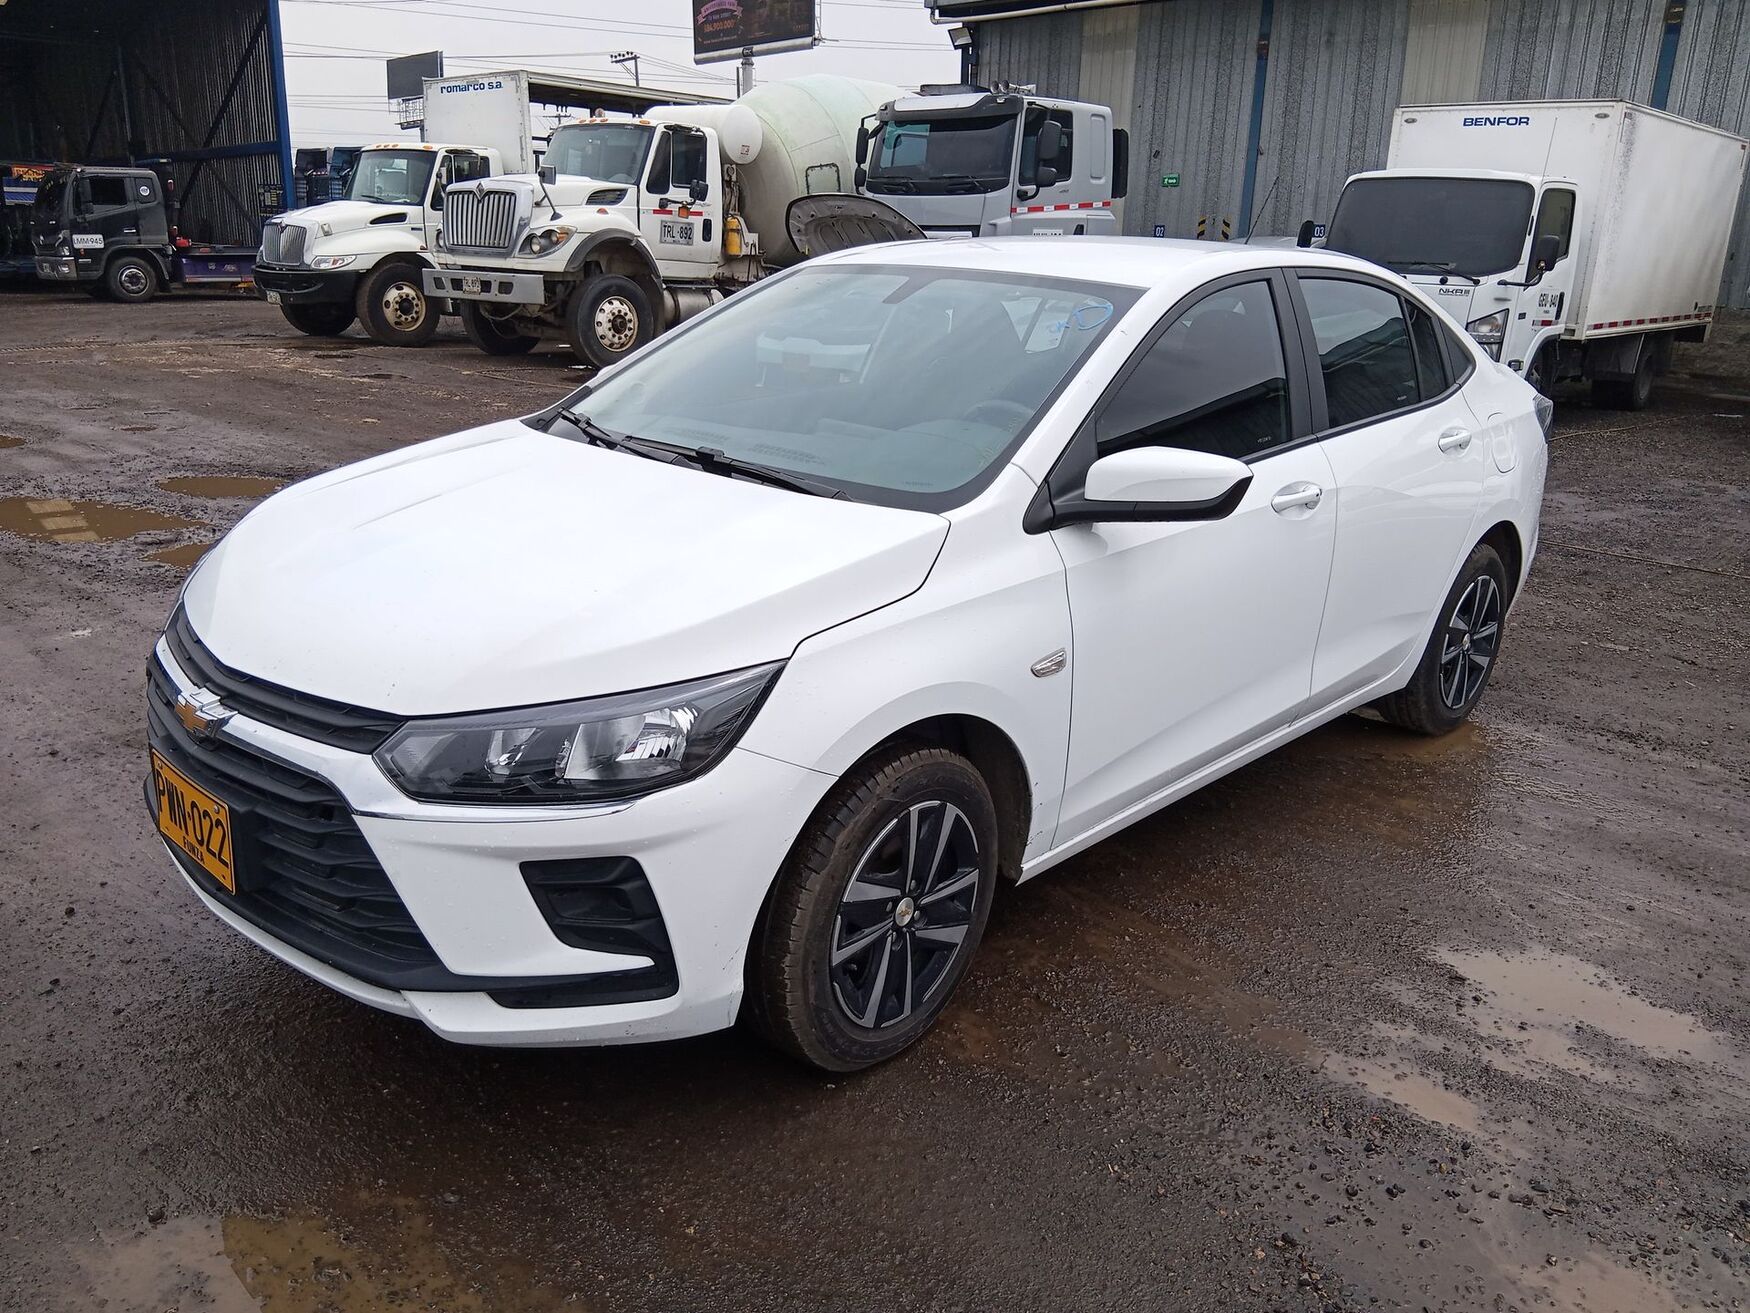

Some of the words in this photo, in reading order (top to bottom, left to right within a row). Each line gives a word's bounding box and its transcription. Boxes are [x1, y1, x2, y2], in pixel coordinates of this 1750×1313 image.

[440, 82, 485, 94] romarco
[1463, 116, 1530, 126] BENFOR
[1155, 226, 1164, 237] 02
[1314, 226, 1324, 237] 03
[183, 835, 205, 865] FUNZA
